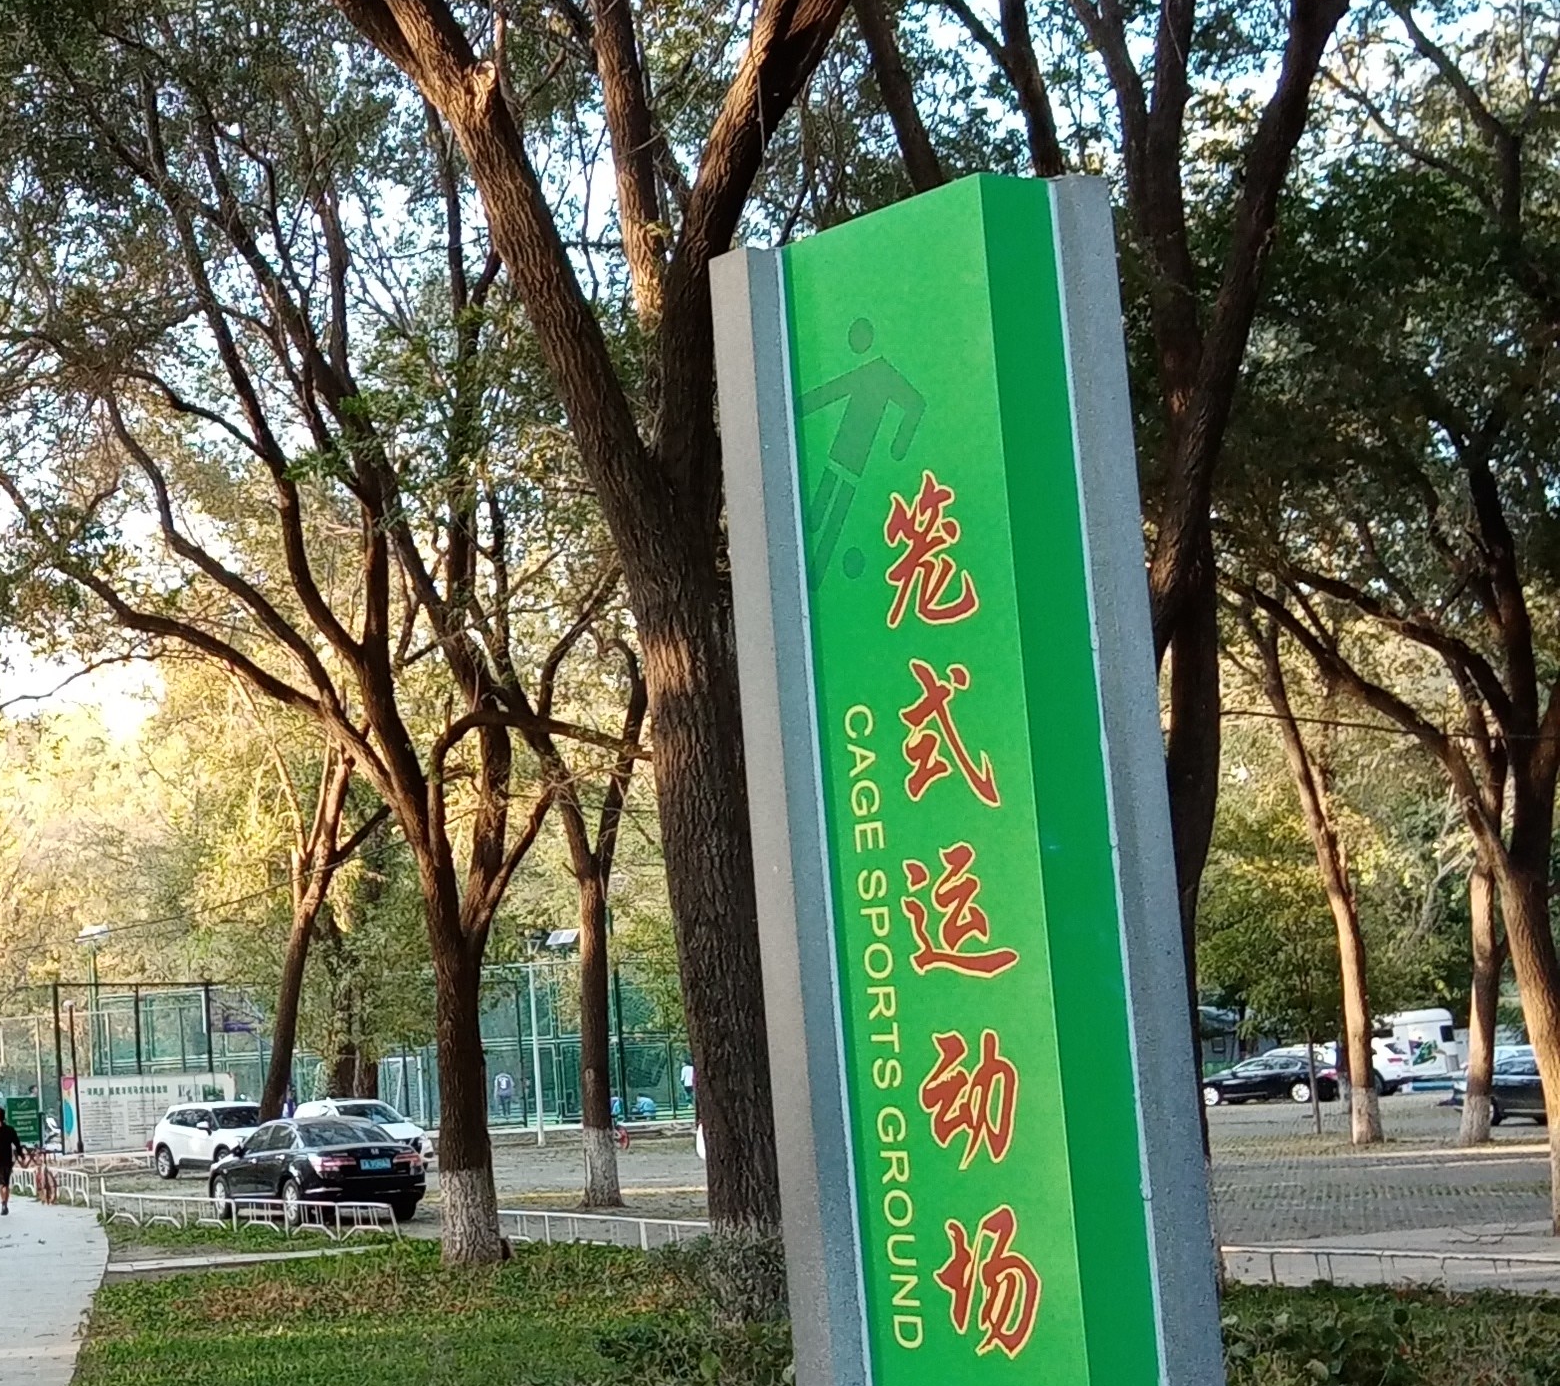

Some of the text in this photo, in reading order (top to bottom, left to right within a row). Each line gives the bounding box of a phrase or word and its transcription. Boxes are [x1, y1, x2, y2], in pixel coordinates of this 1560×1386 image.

[844, 704, 924, 1350] CAGE SPORTS GROUND
[882, 468, 1043, 1361] 笼式运动场
